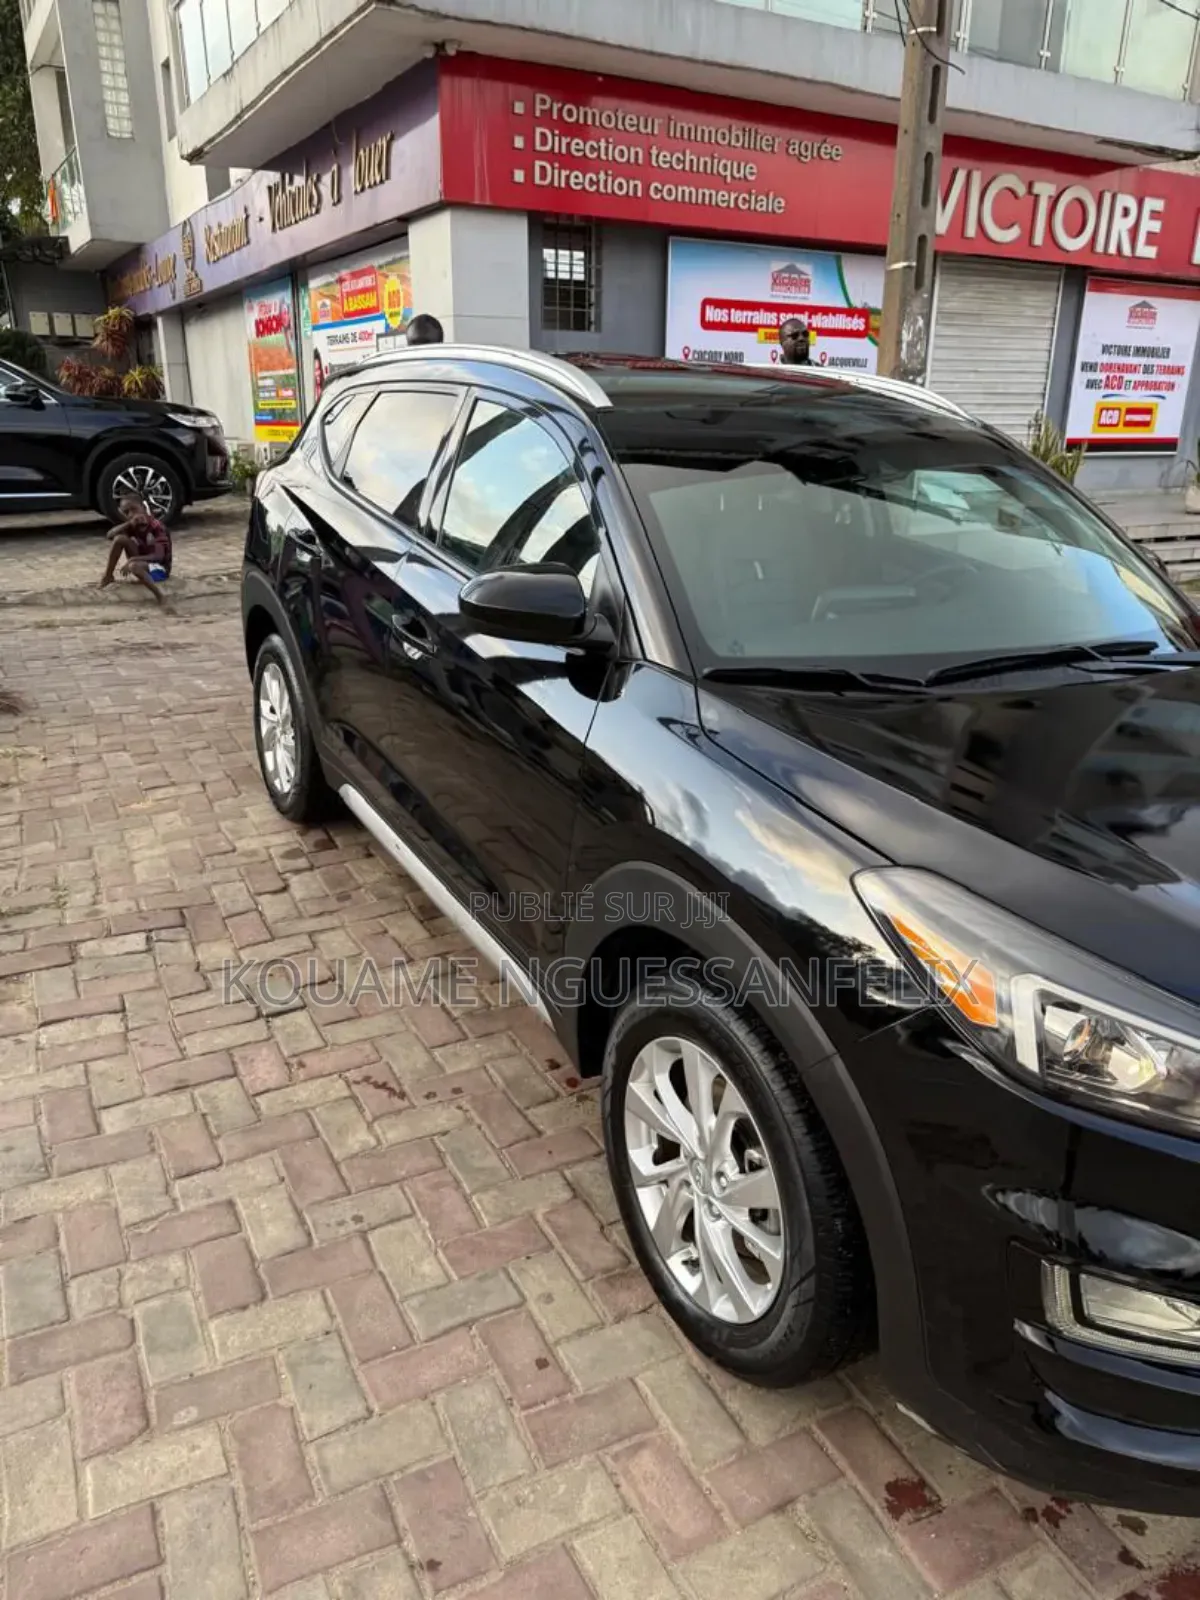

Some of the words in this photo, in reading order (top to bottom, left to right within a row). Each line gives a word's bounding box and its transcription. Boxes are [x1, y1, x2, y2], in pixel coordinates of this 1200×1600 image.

[533, 92, 661, 137] Promoteur
[667, 114, 782, 155] immobilier
[786, 134, 845, 162] agrée
[352, 128, 394, 194] louer
[533, 127, 644, 166] Direction
[649, 144, 758, 184] technique
[532, 161, 643, 199] Direction
[648, 178, 787, 214] commerciale
[936, 167, 1166, 260] VICTOIRE
[705, 304, 729, 323] Nos
[730, 307, 777, 325] terrains
[724, 351, 745, 364] NORD
[1101, 344, 1132, 357] VICTOIRE
[1132, 345, 1171, 359] IMMOBILIER
[1142, 364, 1155, 374] DES
[1085, 378, 1103, 390] AVEC
[1103, 374, 1124, 391] ACD
[1124, 380, 1132, 391] ET
[1099, 408, 1120, 425] ACD
